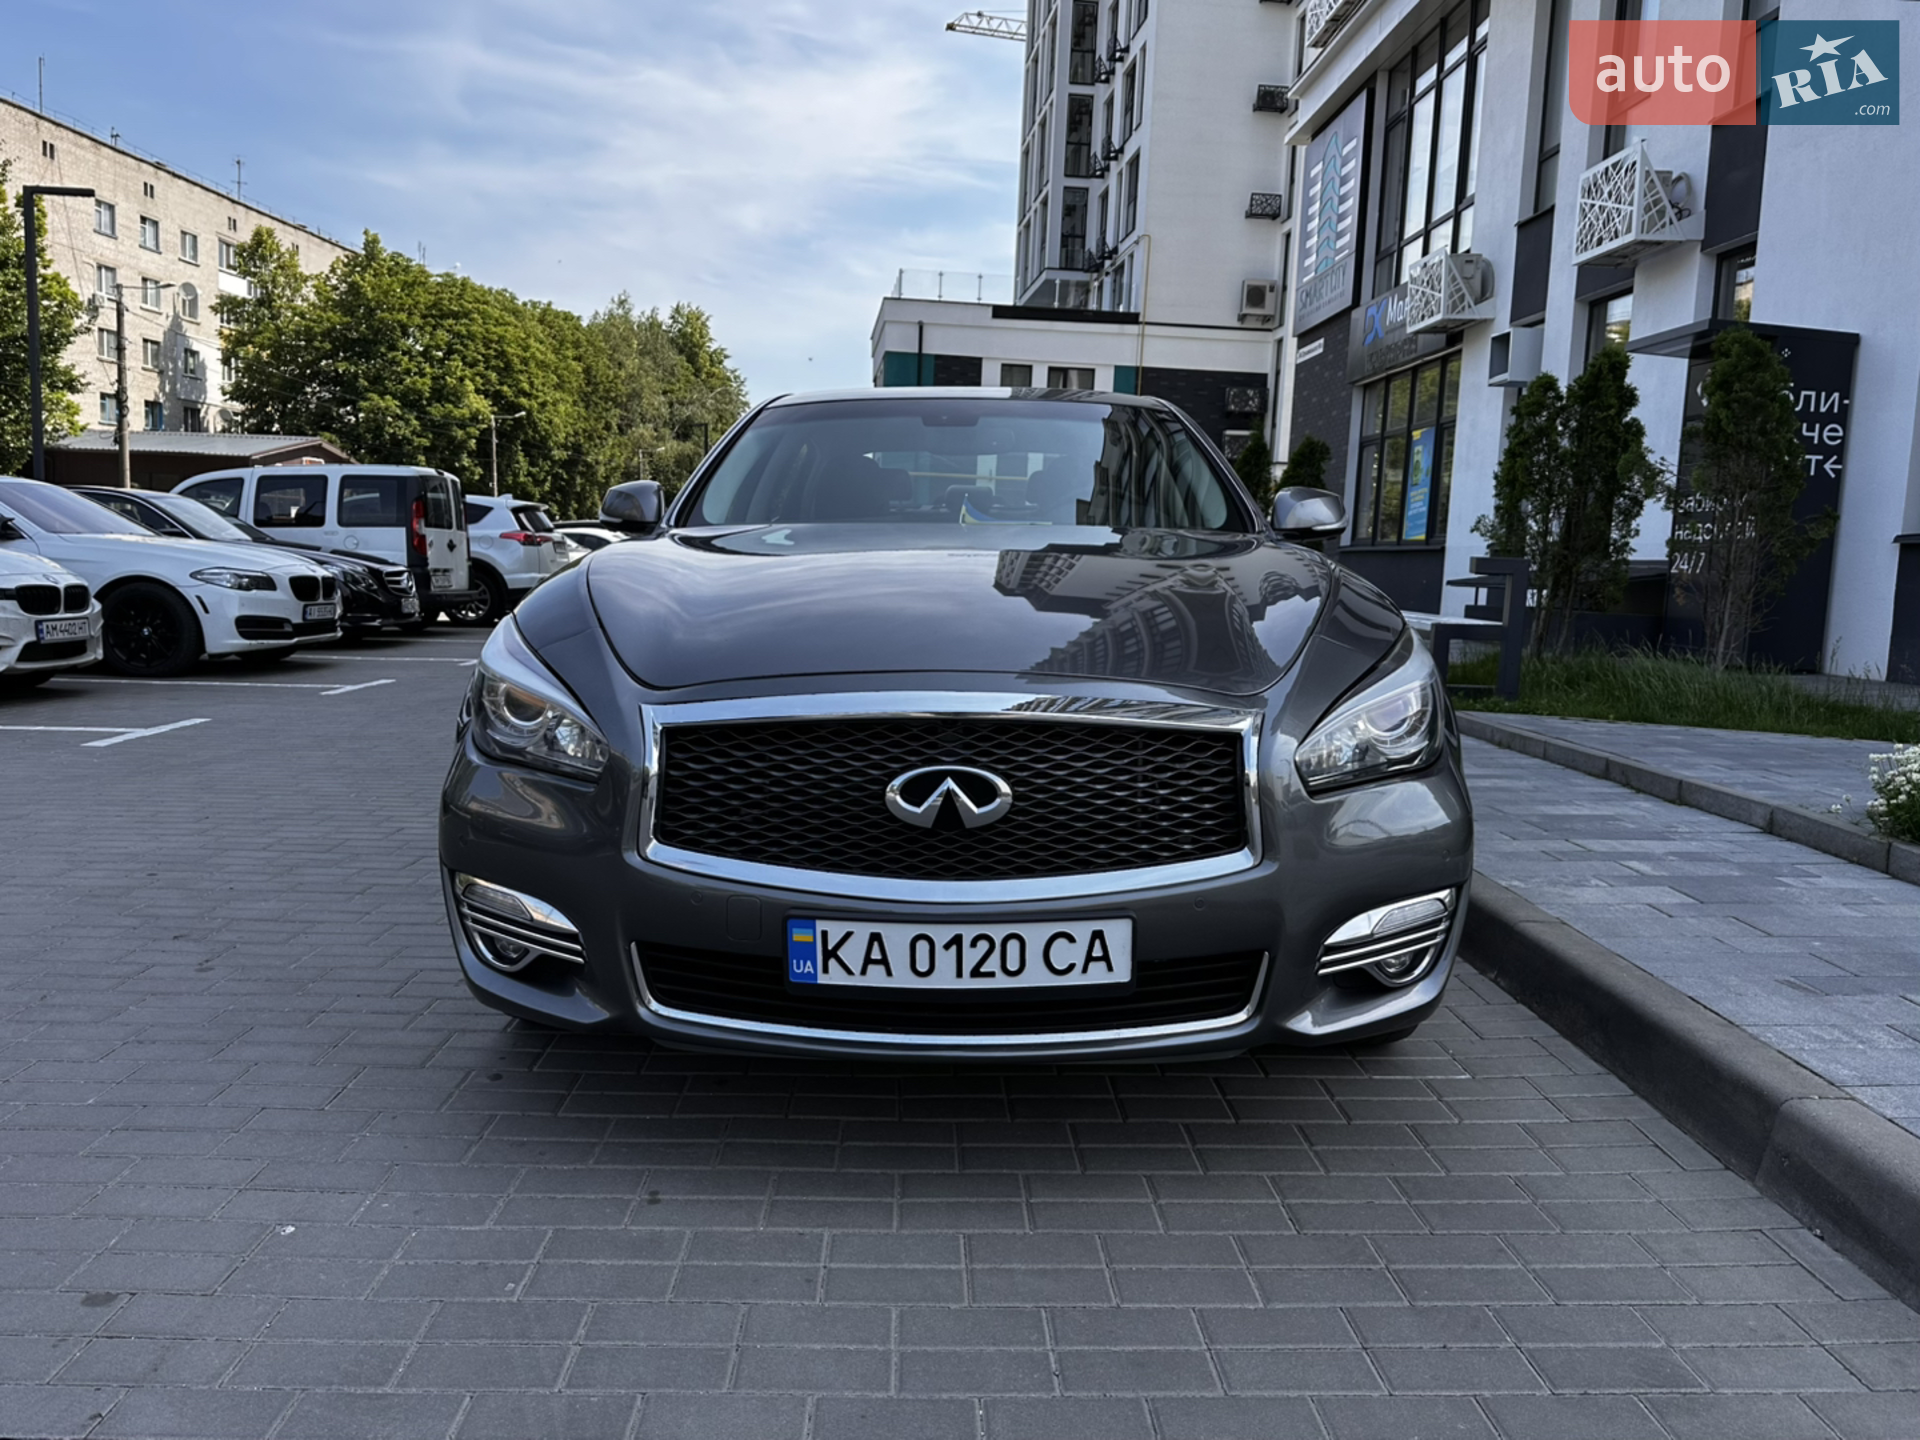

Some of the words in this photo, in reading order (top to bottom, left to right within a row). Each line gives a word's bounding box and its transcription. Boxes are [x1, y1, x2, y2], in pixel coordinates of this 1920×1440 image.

[1670, 551, 1706, 574] 24/7
[820, 929, 894, 977] KA
[909, 932, 1027, 979] 0120
[1042, 929, 1115, 977] CA
[793, 959, 815, 974] UA
